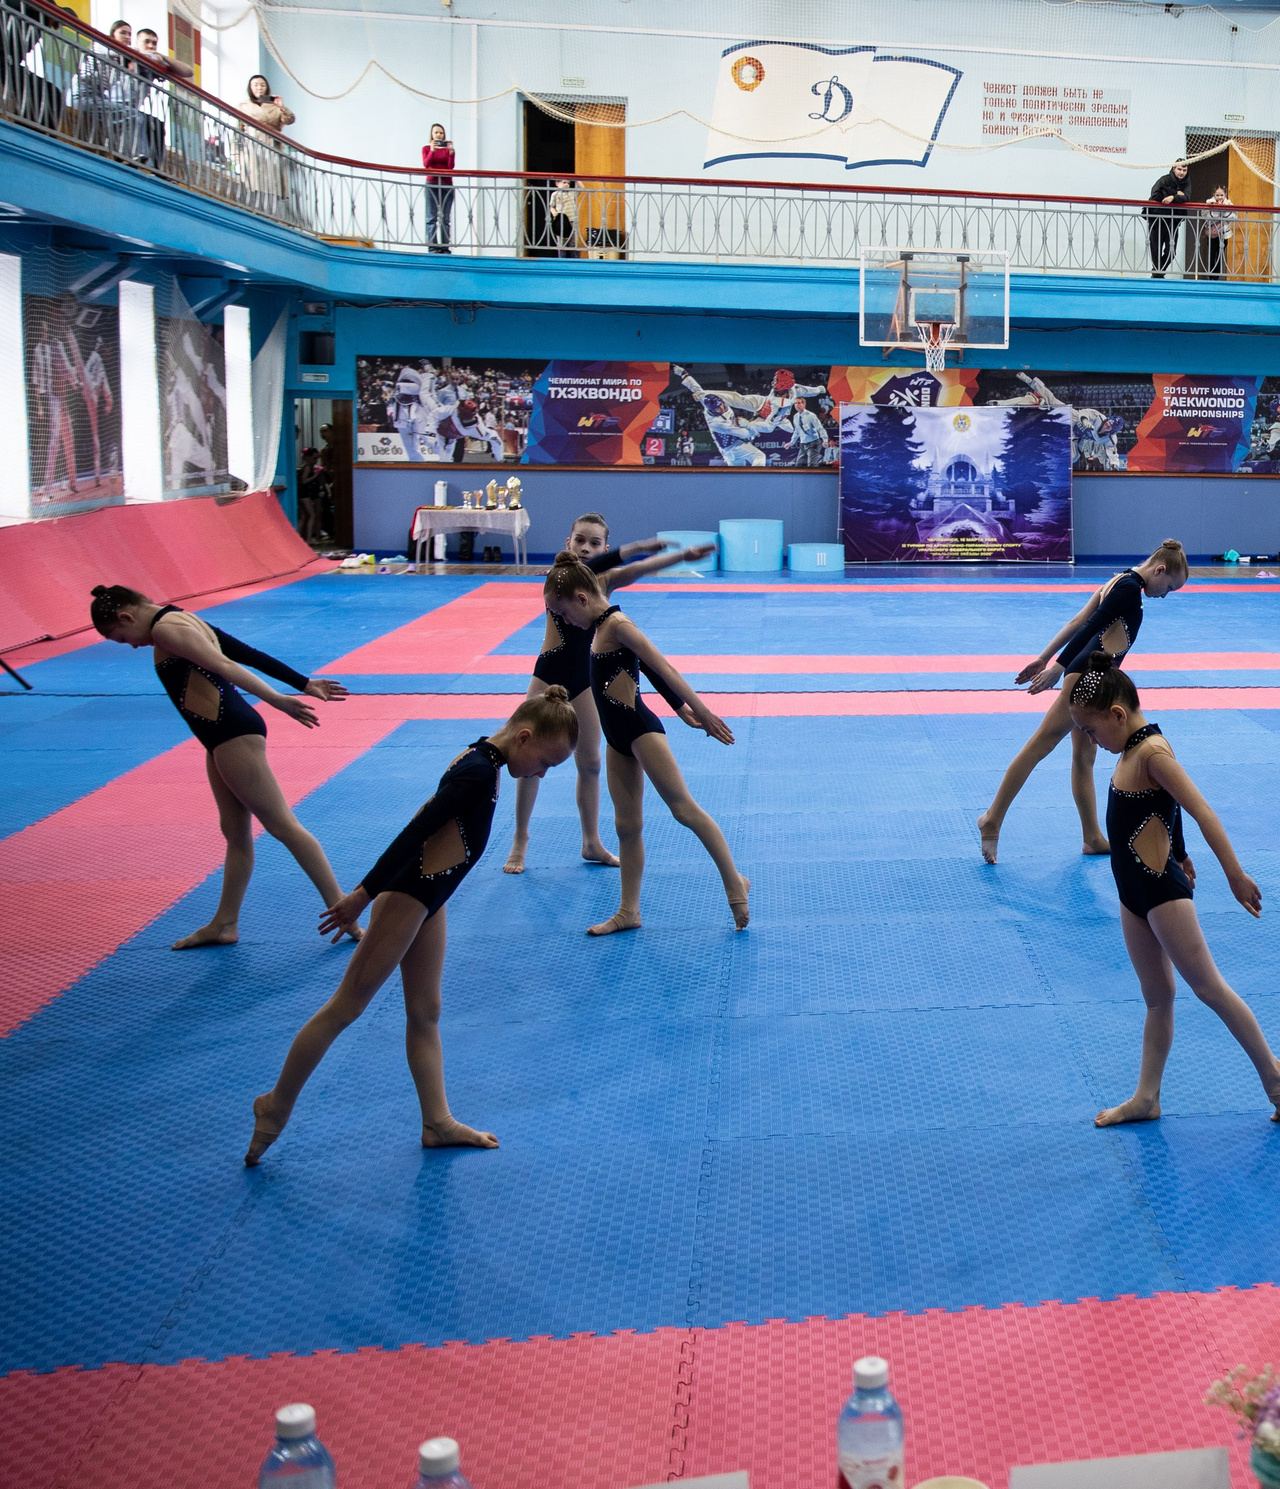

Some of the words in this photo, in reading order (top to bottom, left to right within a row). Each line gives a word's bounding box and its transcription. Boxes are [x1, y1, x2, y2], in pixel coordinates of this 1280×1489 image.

[548, 387, 642, 402] ТХЭКВОНДО
[1163, 396, 1245, 408] TAEKWONDO
[1163, 409, 1244, 418] CHAMPIONSHIPS
[650, 439, 658, 450] 2
